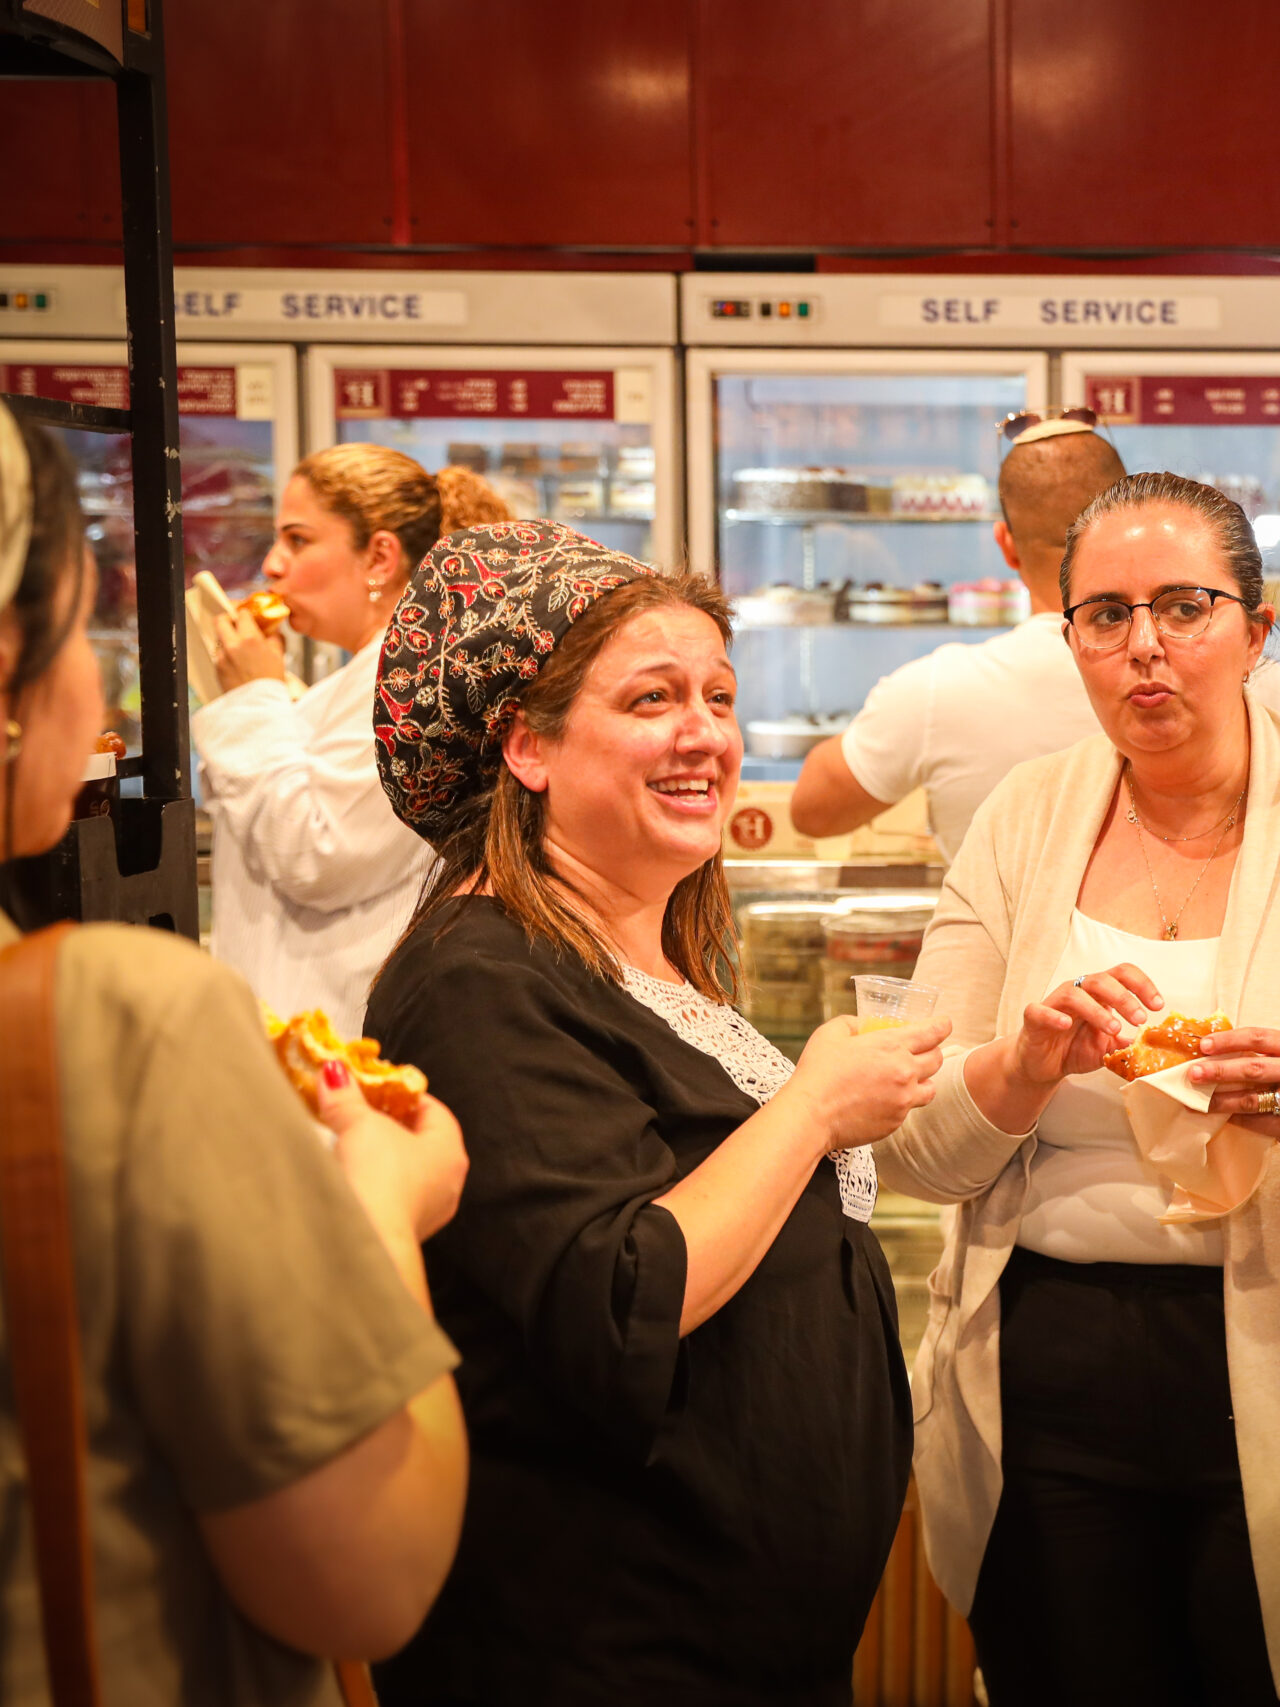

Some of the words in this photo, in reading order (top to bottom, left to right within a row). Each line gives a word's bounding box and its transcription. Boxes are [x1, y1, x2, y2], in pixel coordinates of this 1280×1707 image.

[280, 293, 422, 319] SERVICE
[921, 298, 999, 324] SELF
[1040, 299, 1178, 325] SERVICE
